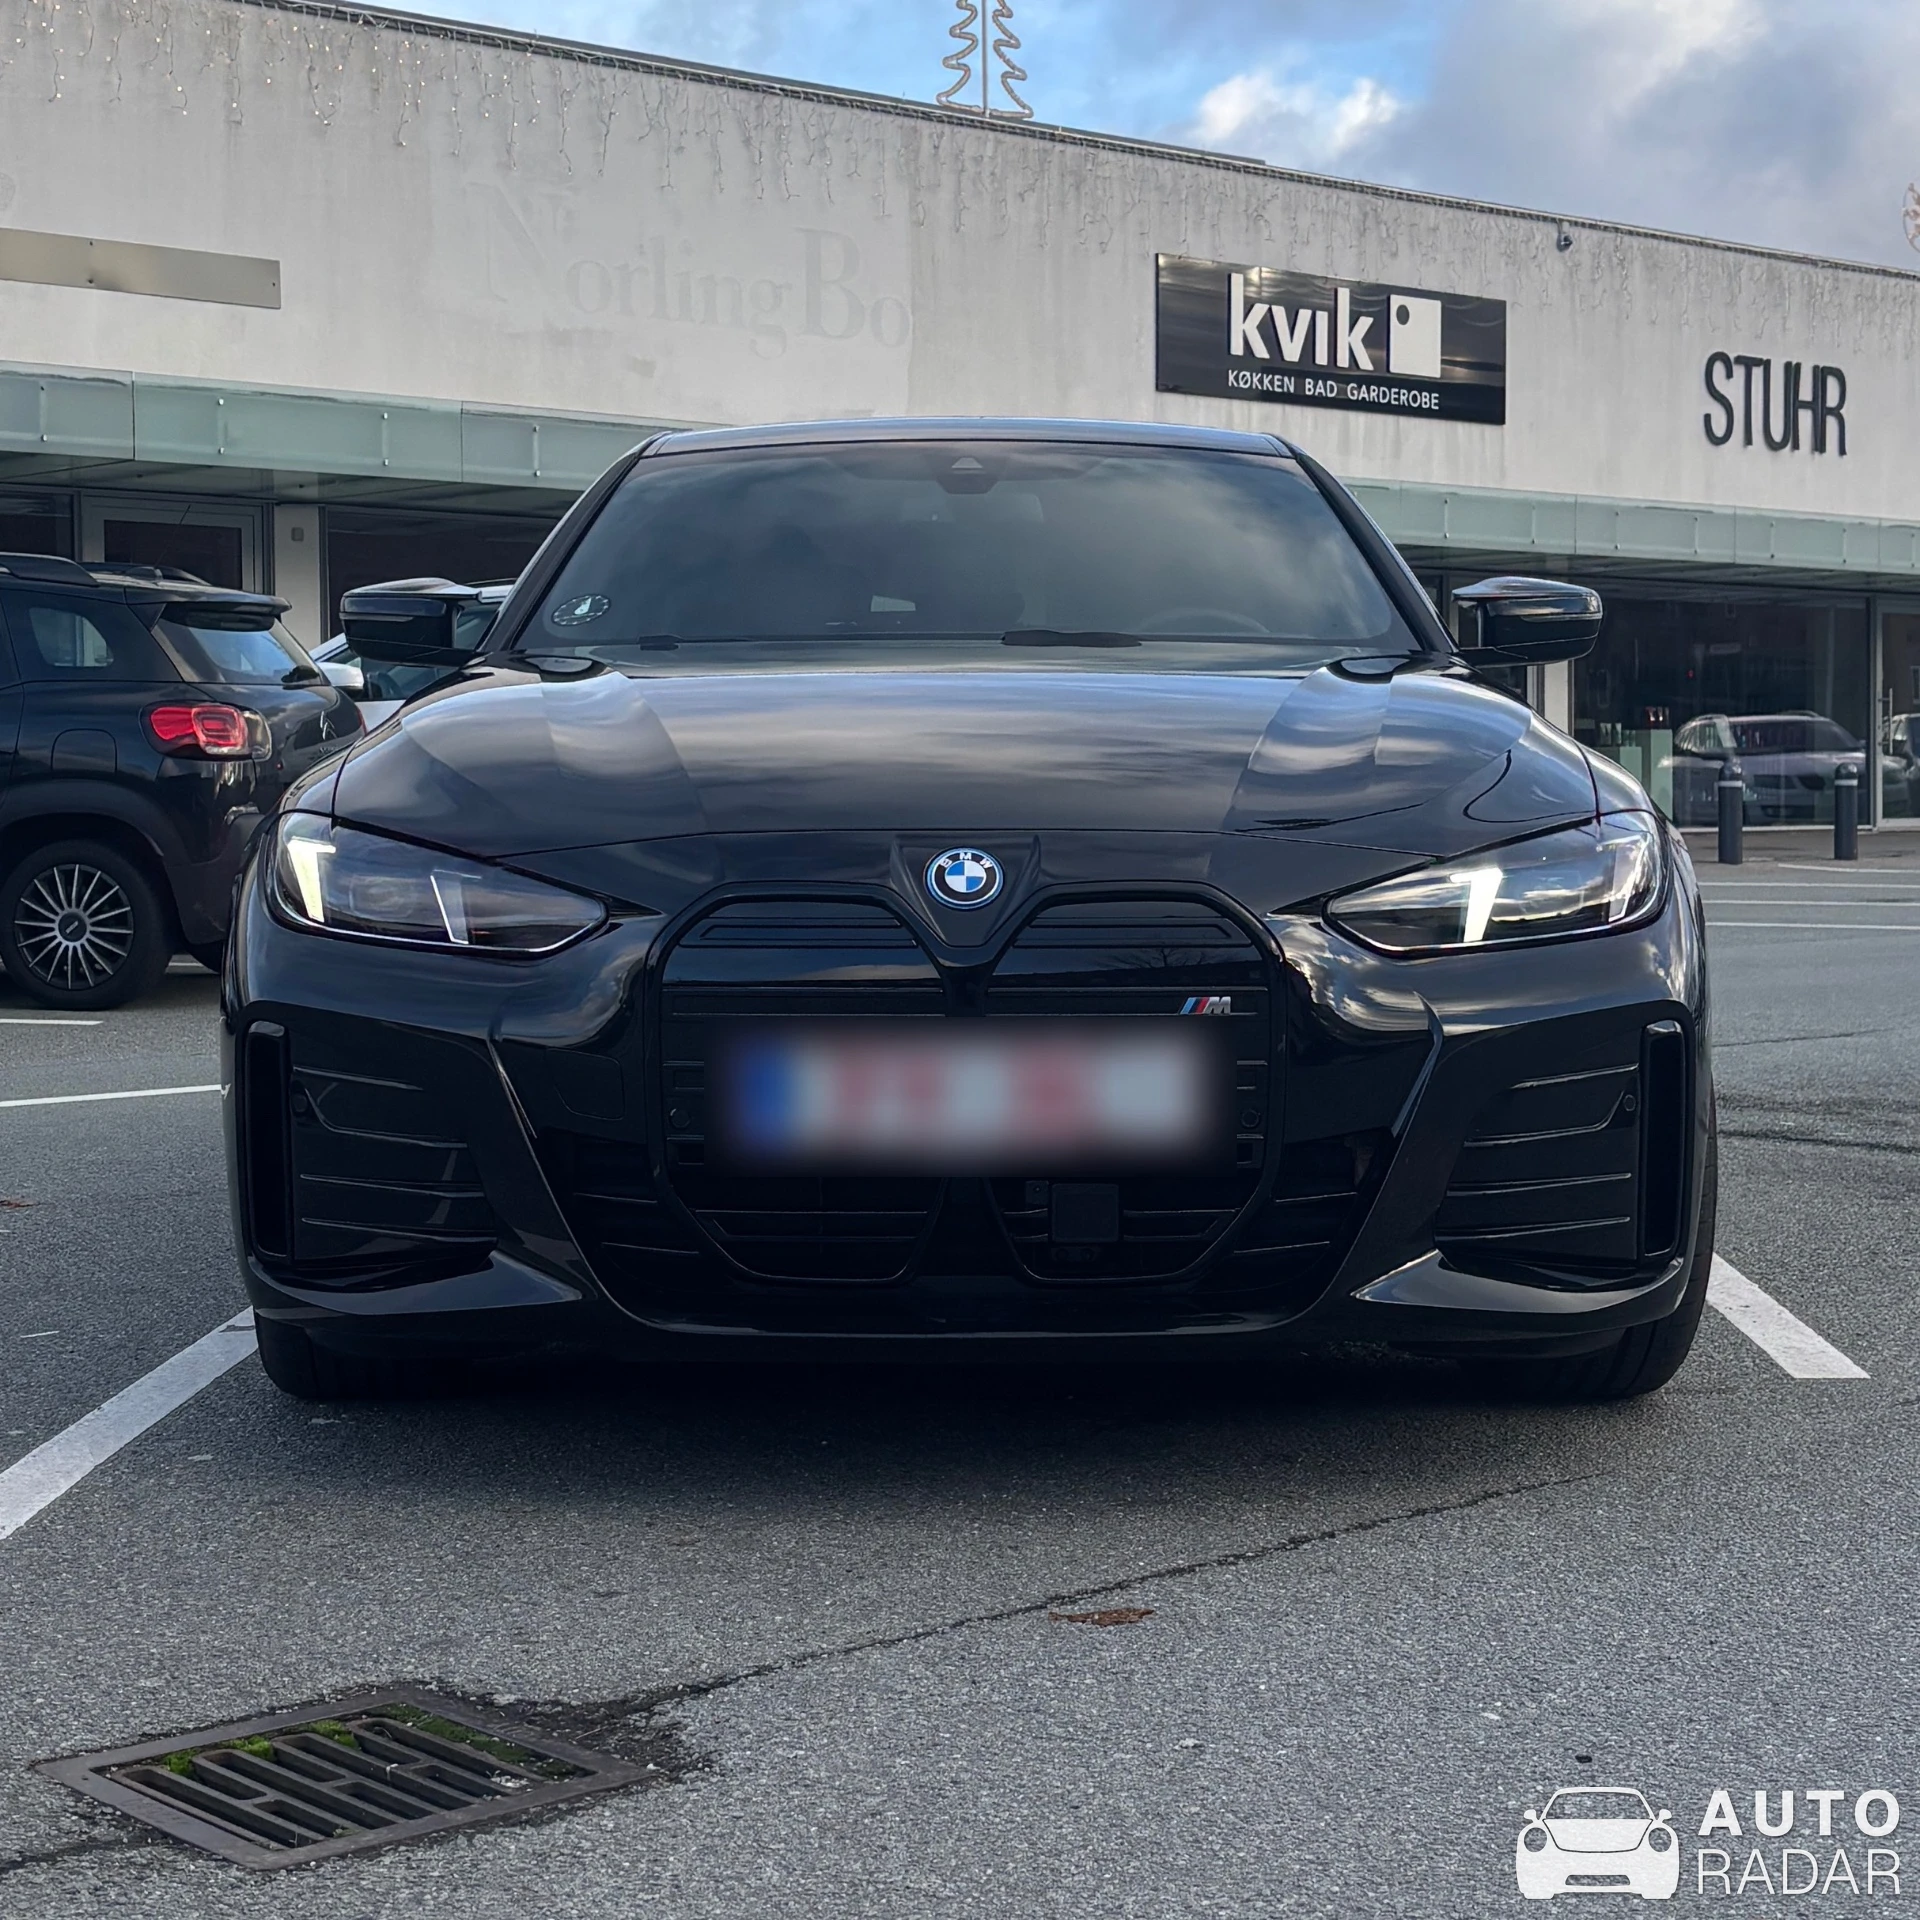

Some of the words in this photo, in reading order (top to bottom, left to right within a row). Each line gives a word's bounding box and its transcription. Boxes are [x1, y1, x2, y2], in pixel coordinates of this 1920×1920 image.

[1228, 272, 1375, 371] kvik
[1228, 369, 1295, 394] KØKKEN
[1305, 378, 1338, 398] BAD
[1347, 382, 1440, 410] GARDEROBE
[1704, 351, 1847, 457] STUHR
[939, 852, 994, 869] BMW
